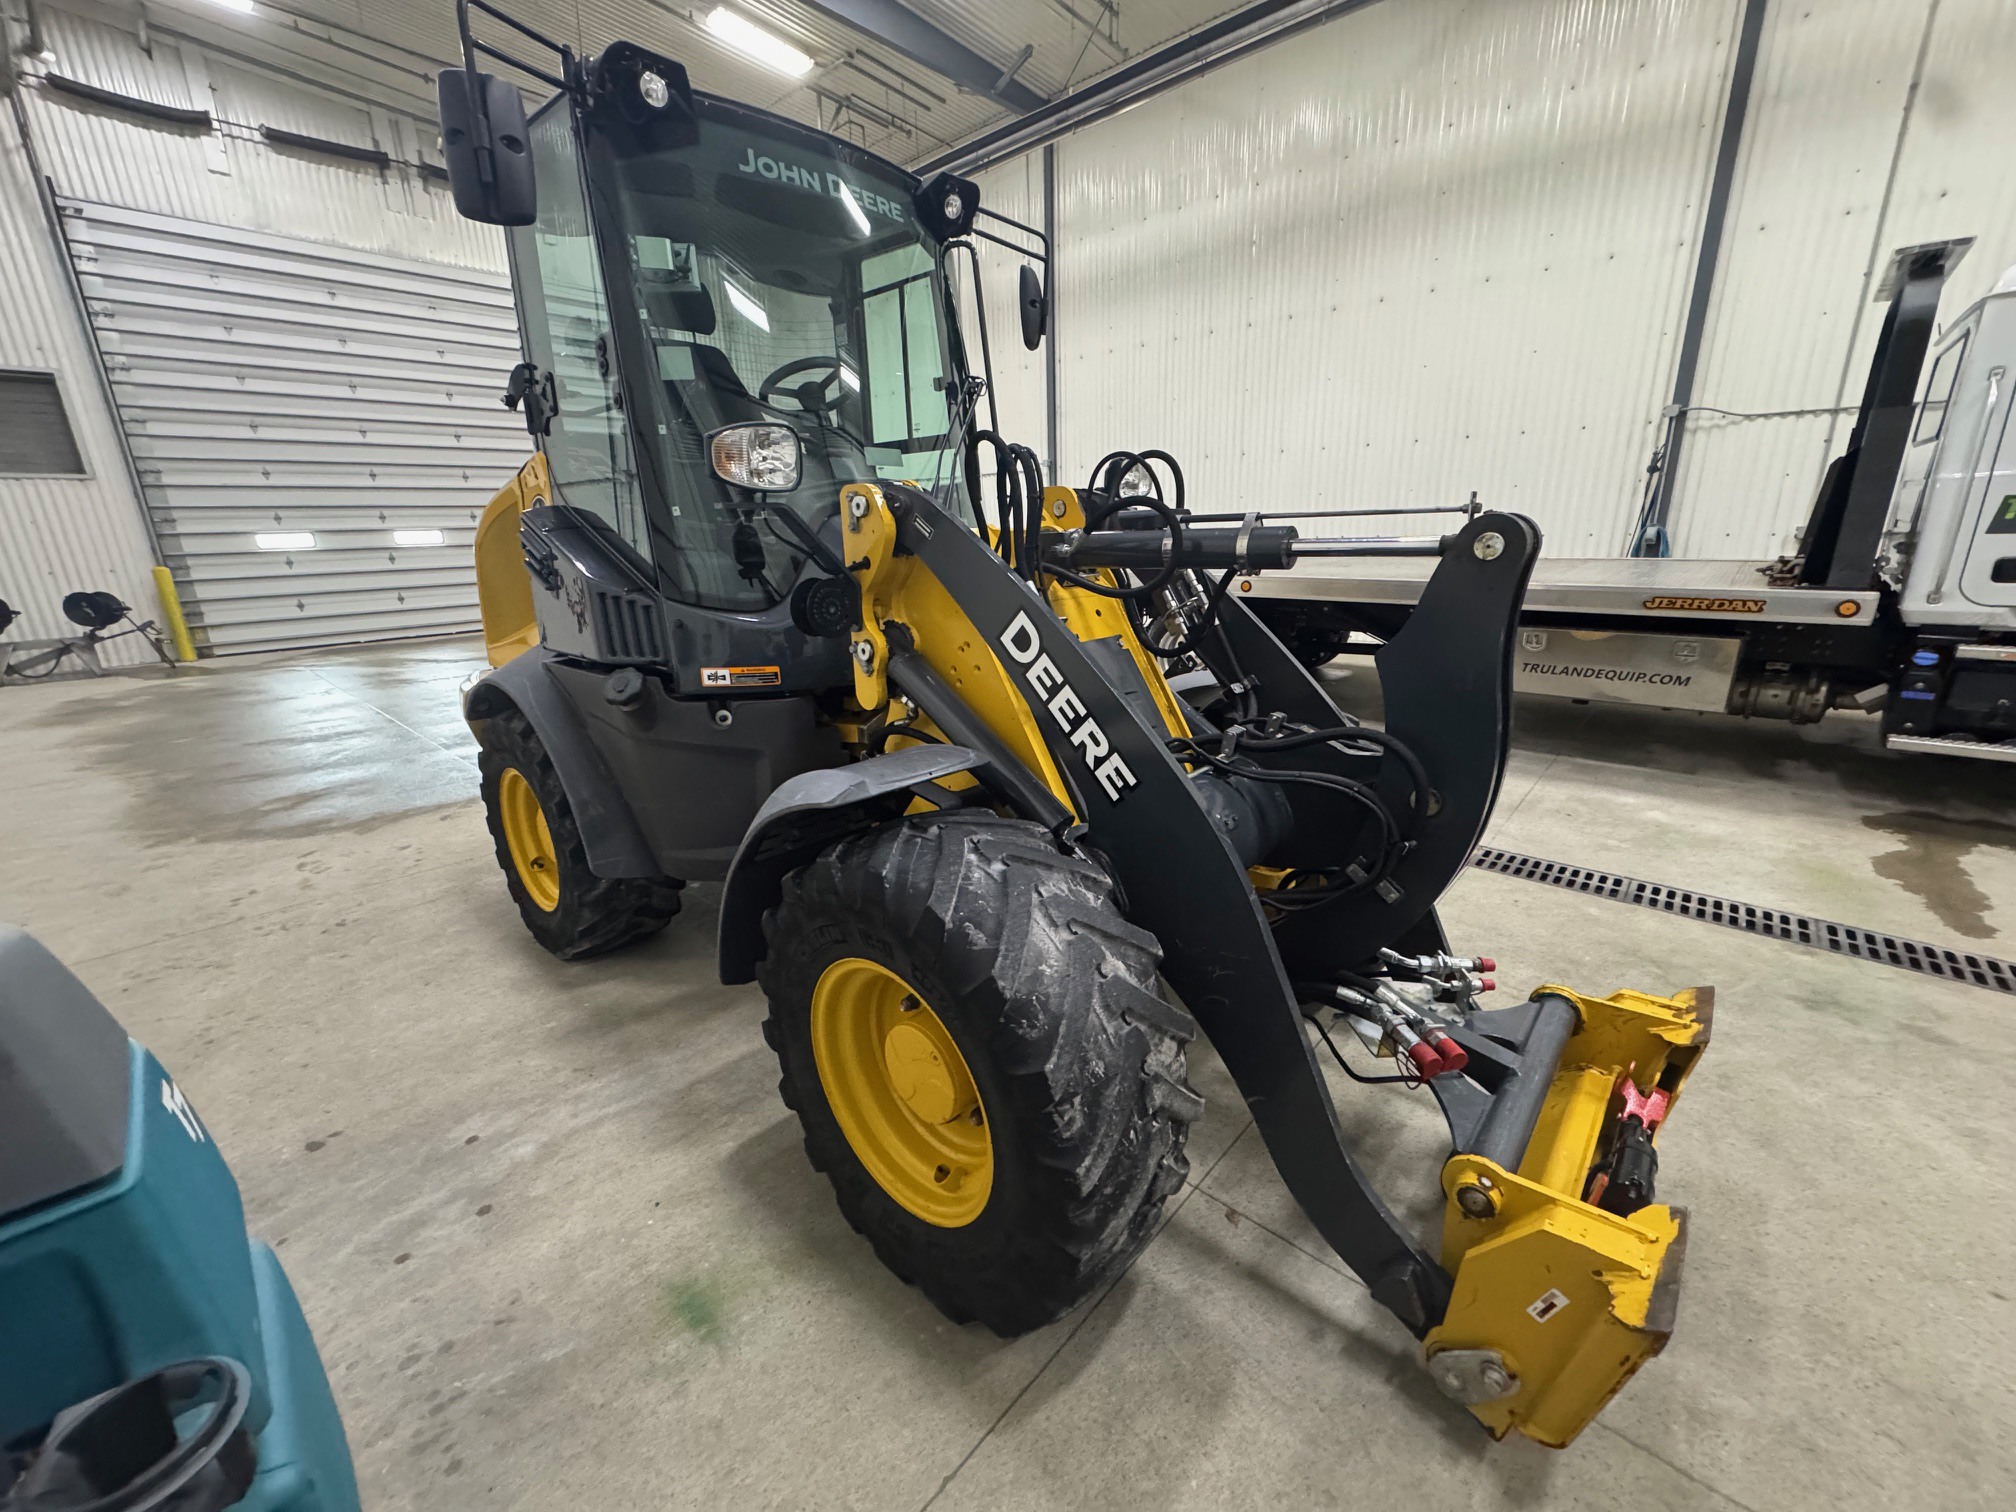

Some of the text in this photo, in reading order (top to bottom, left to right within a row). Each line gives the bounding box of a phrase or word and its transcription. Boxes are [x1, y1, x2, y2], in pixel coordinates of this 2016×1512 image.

[738, 148, 904, 223] JOHN DEERE
[1000, 610, 1137, 802] DEERE
[1522, 662, 1692, 687] TRULANDEQUIP.COM
